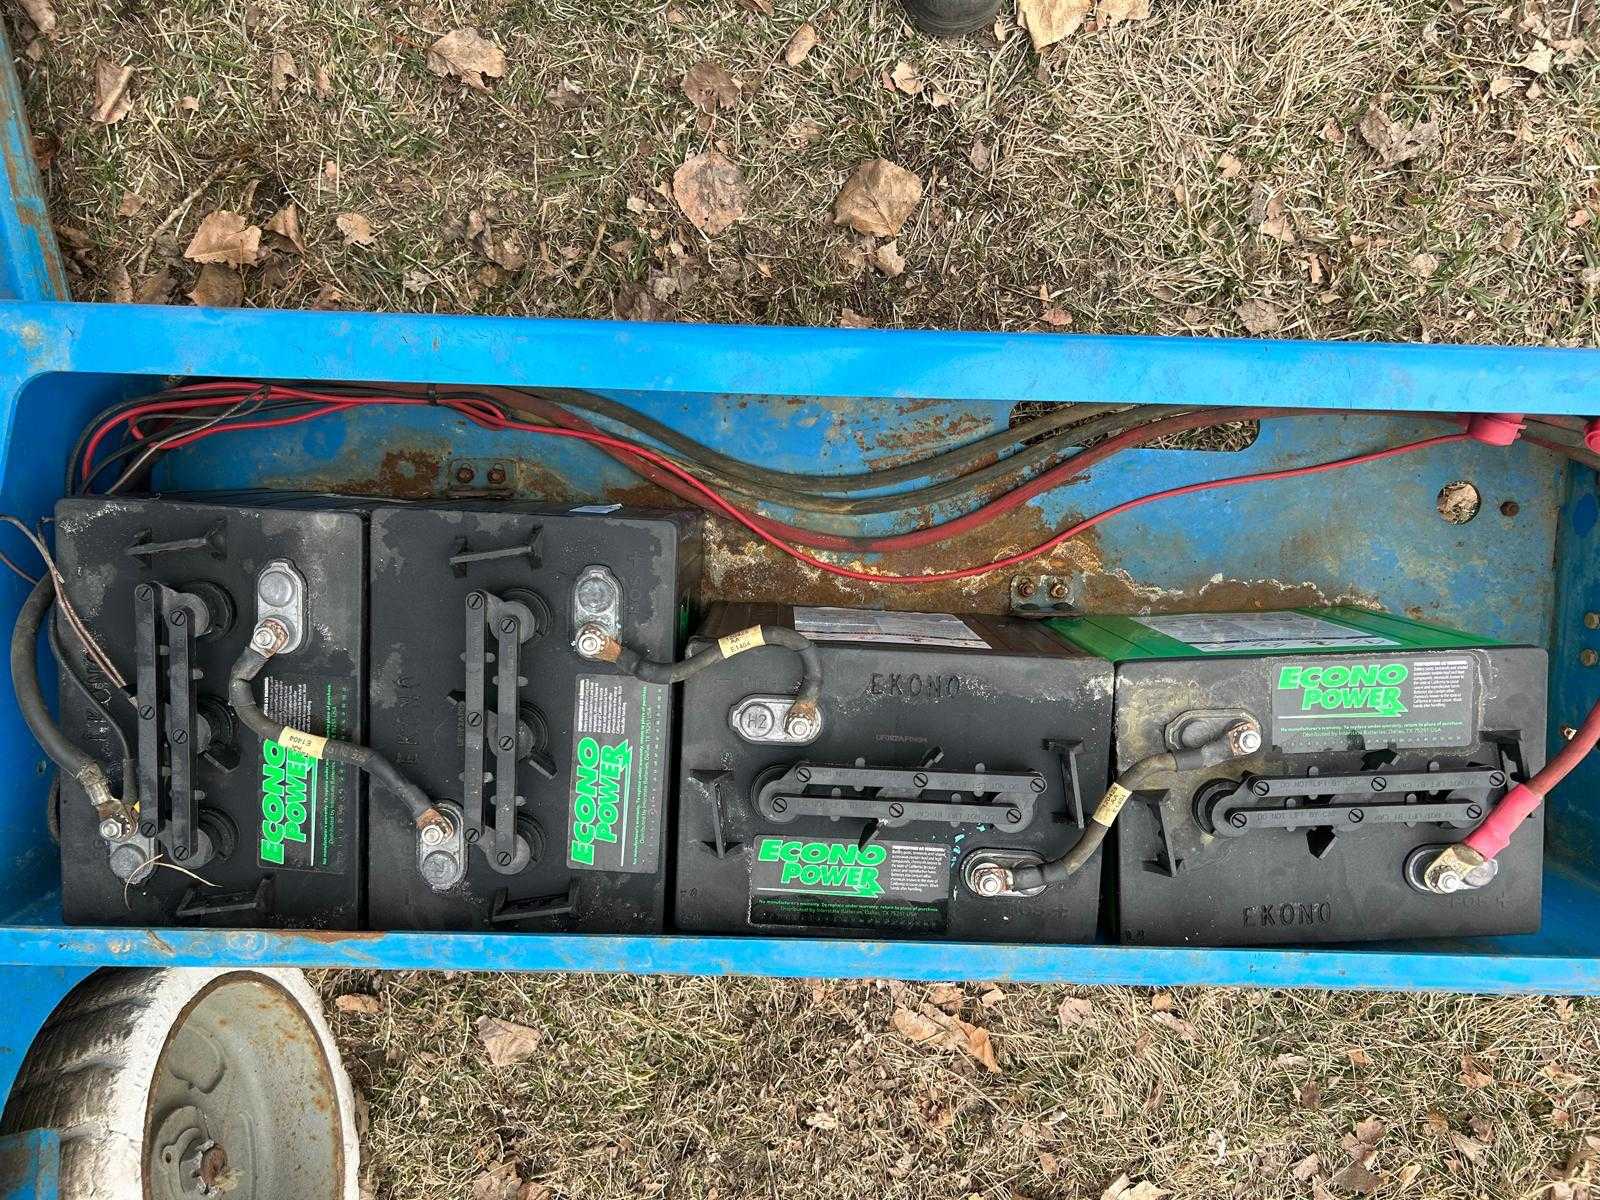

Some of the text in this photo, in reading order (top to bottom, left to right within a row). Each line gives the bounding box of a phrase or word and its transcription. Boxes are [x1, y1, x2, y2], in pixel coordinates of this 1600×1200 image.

[867, 672, 961, 698] EKONO
[1278, 664, 1409, 689] ECONO
[1302, 687, 1408, 714] POWER
[747, 713, 768, 729] H2
[261, 739, 285, 864] ECONO
[571, 737, 600, 865] ECONO
[595, 741, 628, 843] POWER
[758, 839, 887, 866] ECONO
[781, 862, 884, 892] POWER
[1242, 901, 1331, 928] EKONO
